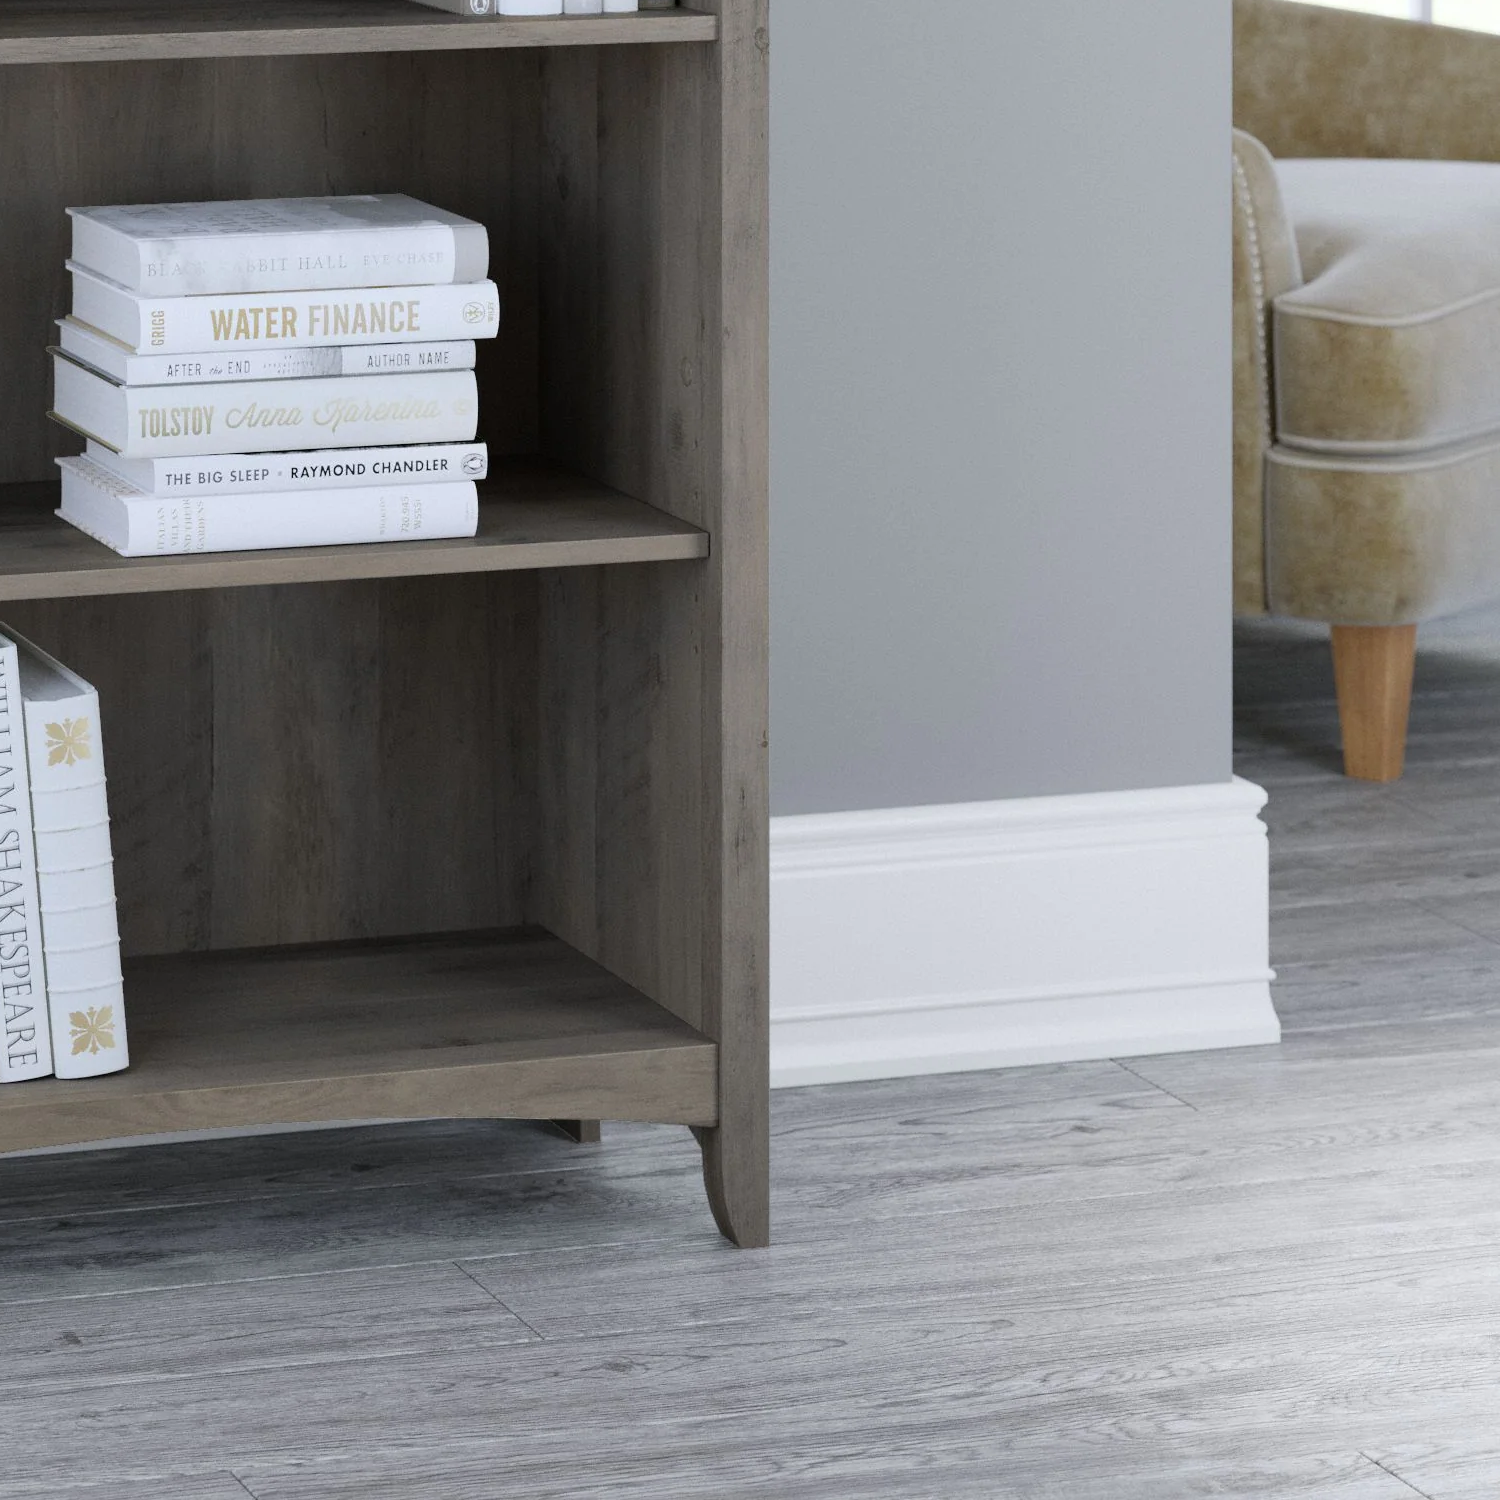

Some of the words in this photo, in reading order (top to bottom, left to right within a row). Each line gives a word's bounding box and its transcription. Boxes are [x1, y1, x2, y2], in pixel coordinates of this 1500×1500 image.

[299, 255, 348, 270] HALL
[151, 310, 165, 346] GRIGG
[210, 306, 298, 341] WATER
[308, 300, 421, 336] FINANCE
[167, 363, 202, 377] AFTER
[209, 366, 223, 375] the
[228, 361, 251, 375] END
[367, 353, 410, 367] AUTHOR
[418, 352, 450, 365] NAME
[139, 406, 215, 438] TOLSTOY
[225, 402, 304, 428] Anna
[313, 397, 441, 434] Karenina
[166, 472, 191, 485] THE
[198, 471, 223, 484] BIG
[230, 468, 270, 482] SLEEP
[291, 463, 366, 479] RAYMOND
[372, 459, 448, 474] CHANDLER
